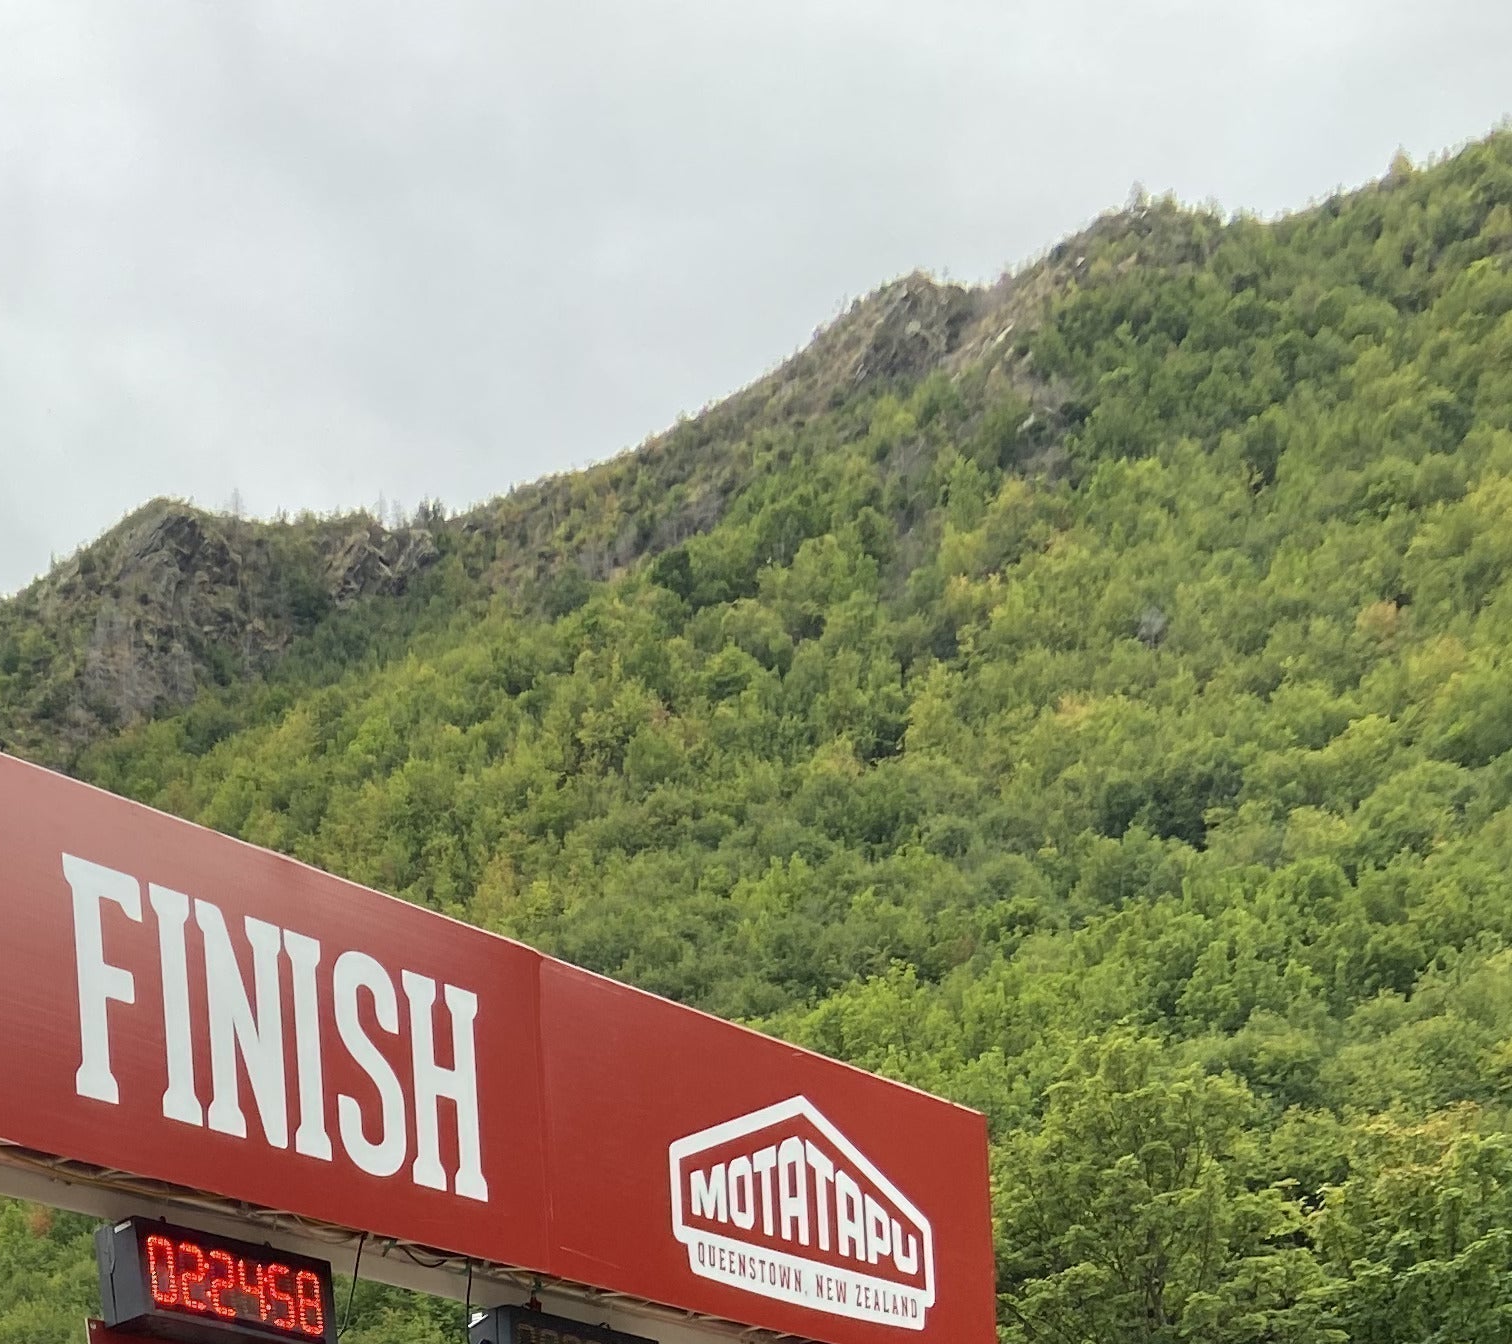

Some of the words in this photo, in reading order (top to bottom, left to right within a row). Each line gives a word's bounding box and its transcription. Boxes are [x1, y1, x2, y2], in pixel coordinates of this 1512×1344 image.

[62, 852, 488, 1203] FINISH
[690, 1136, 919, 1275] MOTATAPU
[697, 1241, 808, 1295] QUEENSTOWN,
[815, 1274, 847, 1304] NEW
[855, 1284, 918, 1319] ZEALAND
